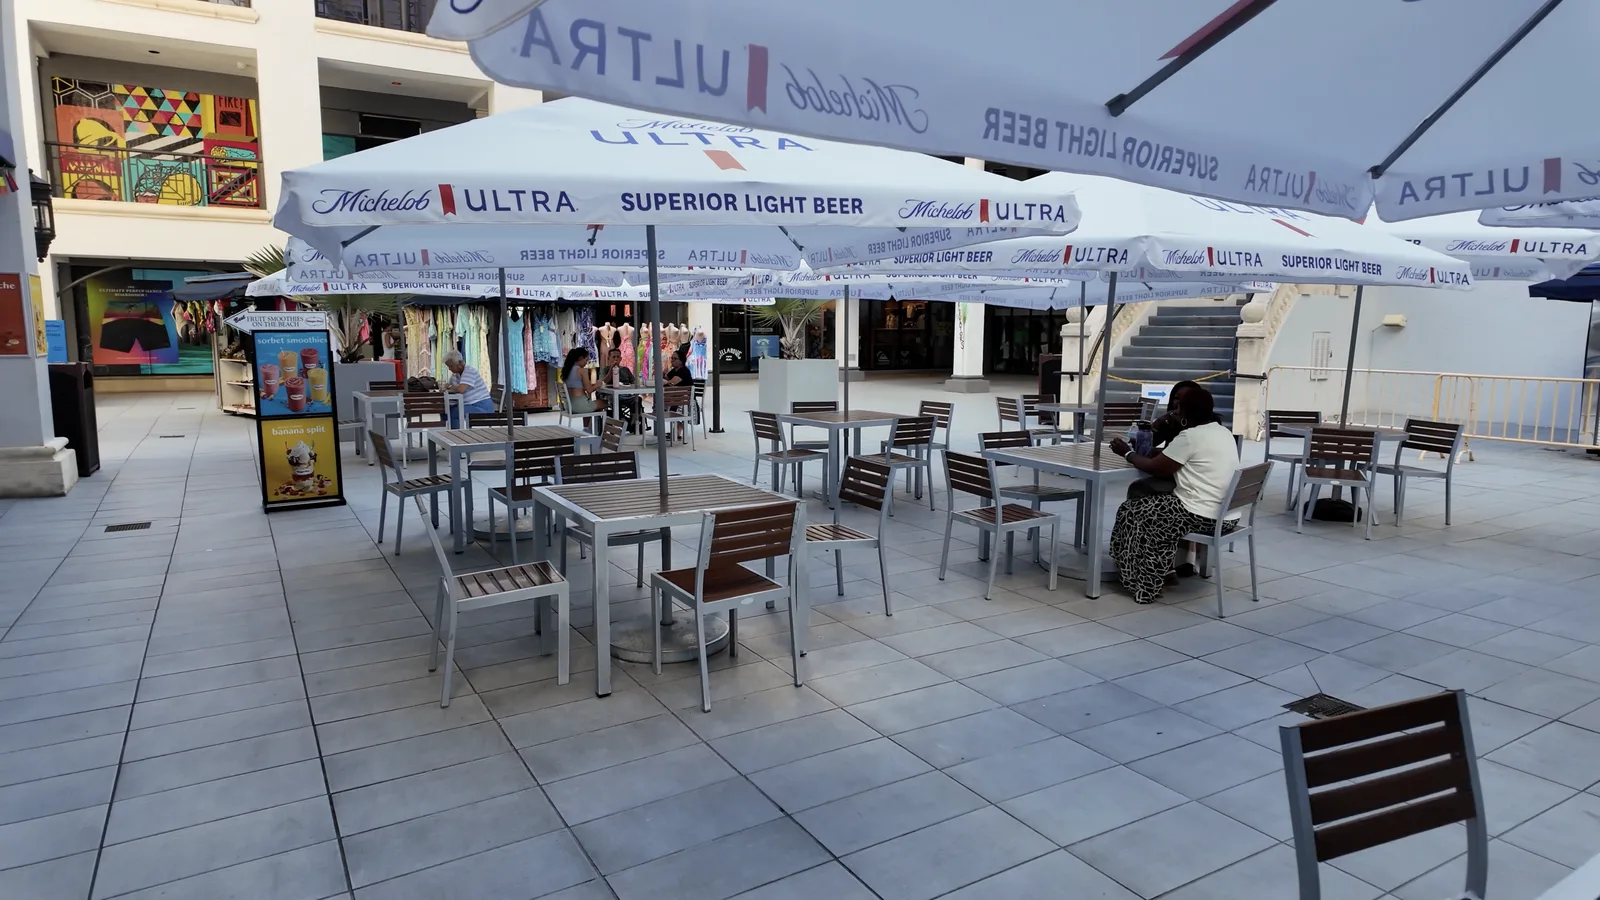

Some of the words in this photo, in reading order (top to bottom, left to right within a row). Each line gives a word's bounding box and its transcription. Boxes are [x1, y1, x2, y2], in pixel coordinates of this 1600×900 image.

[589, 129, 815, 152] ULTRA
[311, 188, 433, 215] Michelob
[463, 188, 577, 213] ULTRA
[620, 192, 739, 212] SUPERIOR
[745, 193, 807, 214] LIGHT
[812, 197, 864, 215] BEER
[898, 198, 976, 220] Michelob
[995, 202, 1066, 223] ULTRA
[893, 251, 935, 264] SUPERIOR
[936, 250, 965, 263] LIGHT
[967, 250, 993, 263] BEER
[1011, 248, 1064, 264] Michelob
[1074, 247, 1129, 264] ULTRA
[1445, 239, 1510, 252] Michelob
[1523, 241, 1588, 256] ULTRA
[1163, 249, 1205, 265] Michelob
[1216, 250, 1263, 267] ULTRA
[1281, 254, 1332, 270] SUPERIOR
[1335, 257, 1362, 273] LIGHT
[1361, 262, 1382, 276] BEER
[1395, 265, 1429, 281] Michelob
[1436, 271, 1471, 286] ULTRA
[288, 283, 322, 293] Michelob
[331, 283, 368, 291] ULTRA
[382, 282, 425, 290] SUPERIOR
[451, 284, 471, 292] BEER
[522, 288, 552, 298] ULTRA
[246, 315, 266, 323] FRUIT
[267, 315, 304, 323] SMOOTHIES
[257, 336, 284, 345] sorbet
[286, 336, 328, 344] smoothies
[272, 427, 304, 436] banana
[306, 425, 326, 434] split
